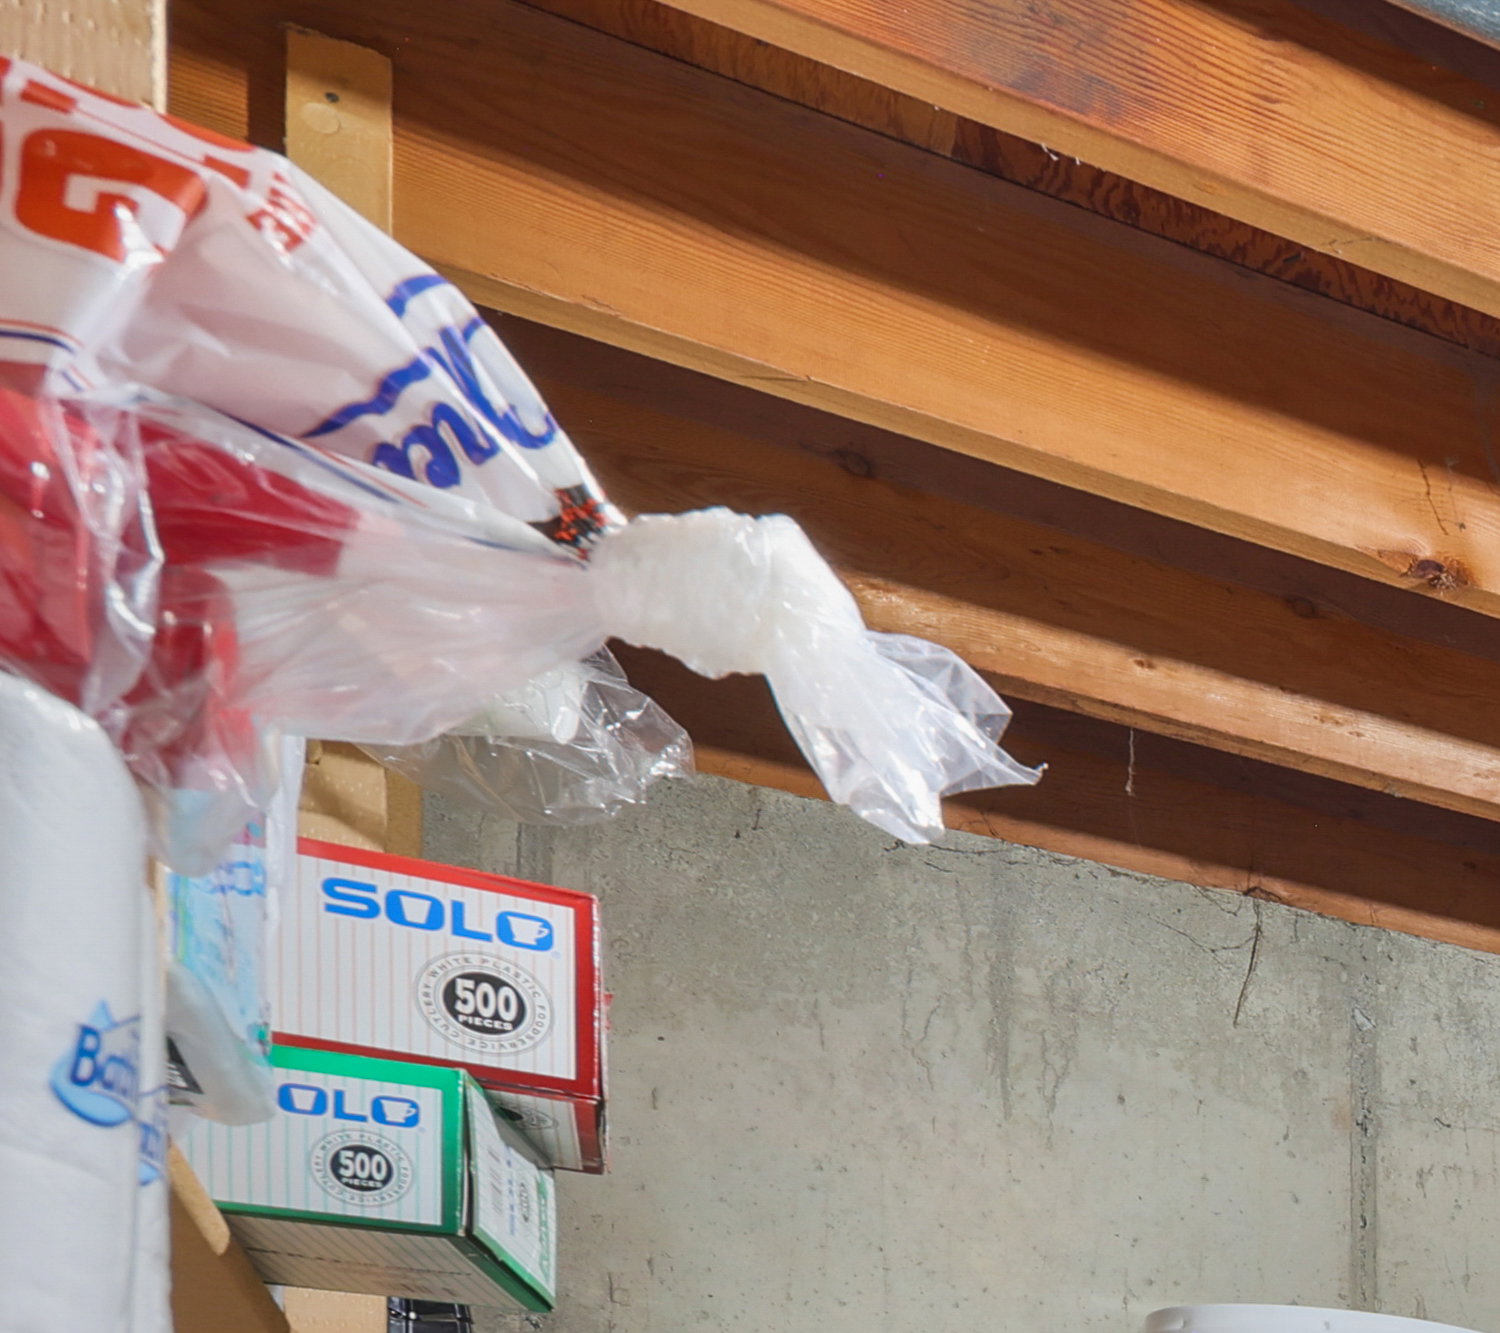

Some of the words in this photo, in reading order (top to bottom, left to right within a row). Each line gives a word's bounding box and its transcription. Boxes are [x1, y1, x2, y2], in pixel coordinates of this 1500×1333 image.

[321, 877, 555, 951] SOLO
[455, 978, 517, 1021] 500
[458, 1014, 513, 1031] PIECES
[339, 1150, 387, 1180] 500
